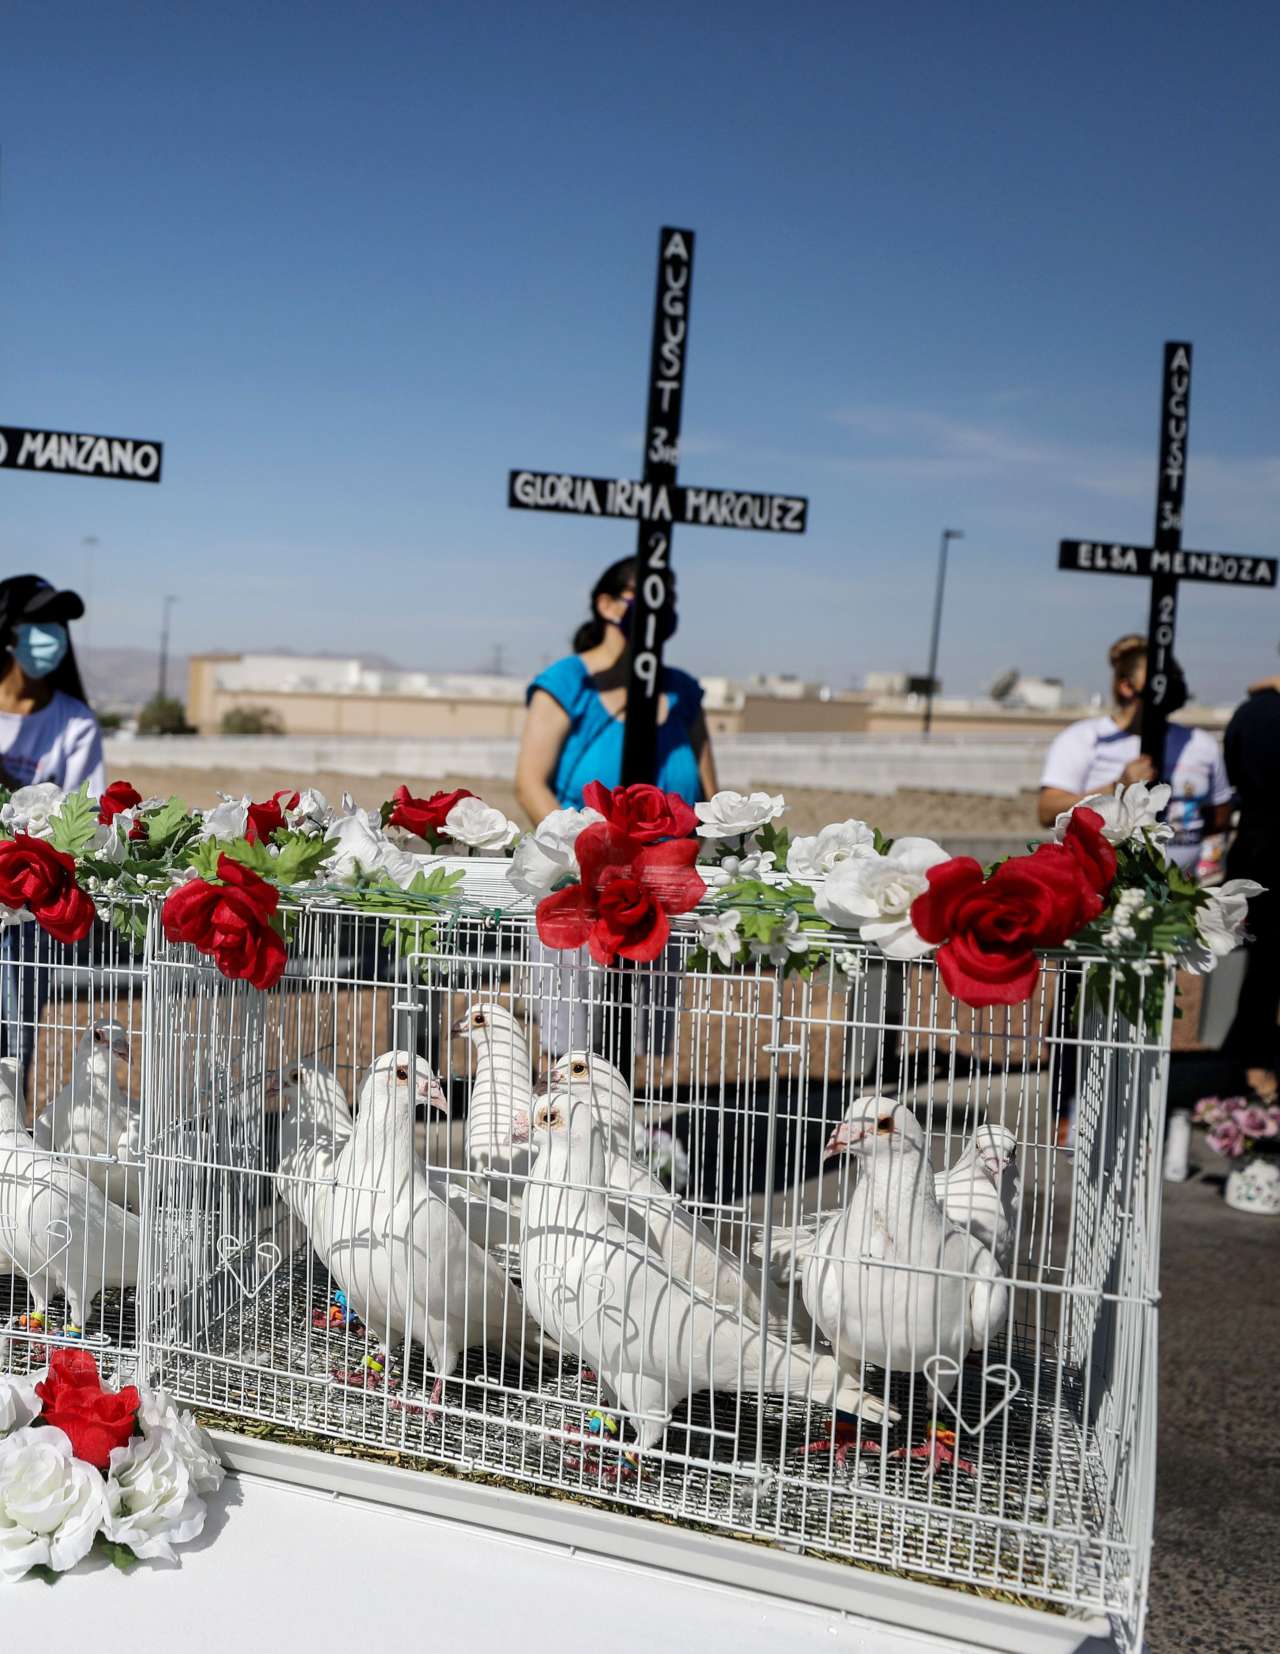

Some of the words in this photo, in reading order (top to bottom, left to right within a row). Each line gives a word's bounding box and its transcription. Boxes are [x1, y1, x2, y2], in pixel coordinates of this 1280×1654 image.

[656, 232, 688, 413] AUGUST
[18, 431, 159, 477] MANZANO
[1165, 347, 1189, 491] AUGUST
[514, 472, 600, 515] GLORIA
[606, 479, 672, 522] IRMA
[685, 490, 805, 531] MARQUEZ
[634, 533, 666, 698] 2019
[1077, 544, 1138, 572] ELSA
[1150, 549, 1271, 582] MENDOZA
[1151, 595, 1174, 705] 2019
